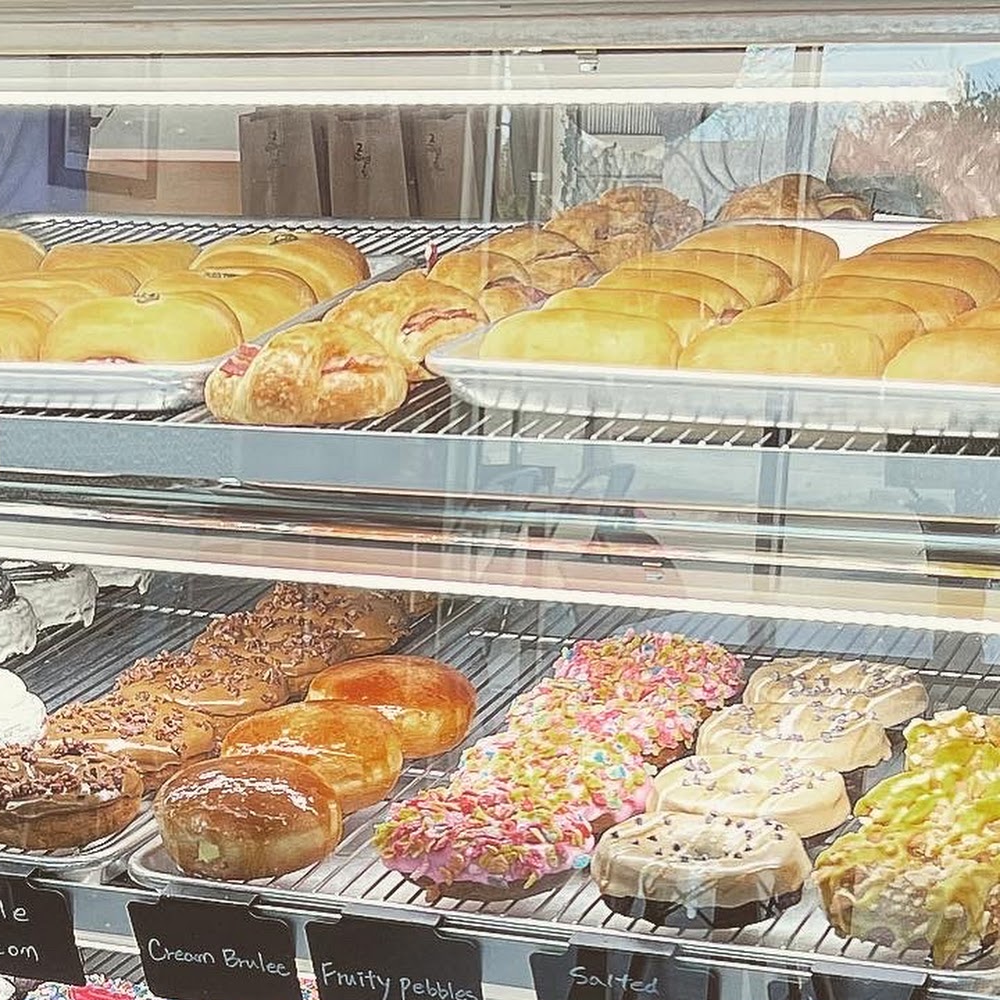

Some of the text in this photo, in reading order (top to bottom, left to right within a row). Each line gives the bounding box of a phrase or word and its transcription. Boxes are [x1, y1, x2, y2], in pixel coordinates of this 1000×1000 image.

[148, 938, 291, 977] Cream Brulee
[569, 966, 660, 995] Salted
